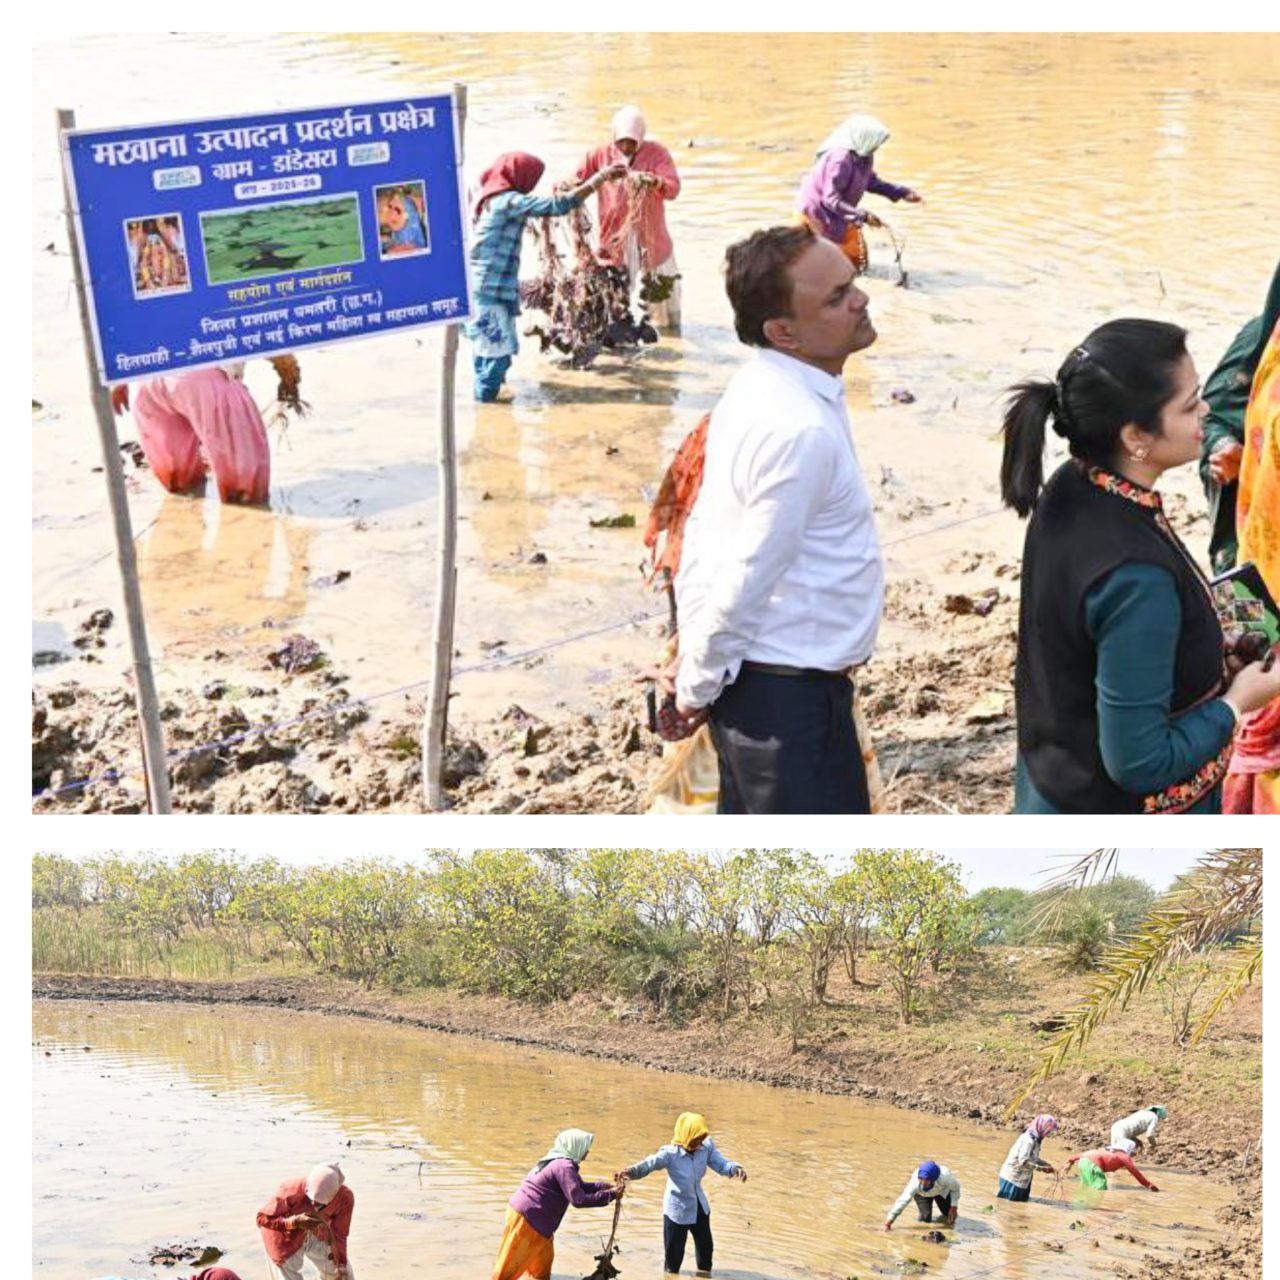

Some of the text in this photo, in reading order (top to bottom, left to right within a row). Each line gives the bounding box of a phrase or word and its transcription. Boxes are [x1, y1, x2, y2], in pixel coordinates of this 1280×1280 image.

[91, 102, 436, 167] मखाना उत्पादन प्रदर्शन प्रक्षेत्र
[211, 160, 253, 181] ग्राम
[271, 148, 338, 173] डांडेसरा
[200, 317, 236, 334] जिला
